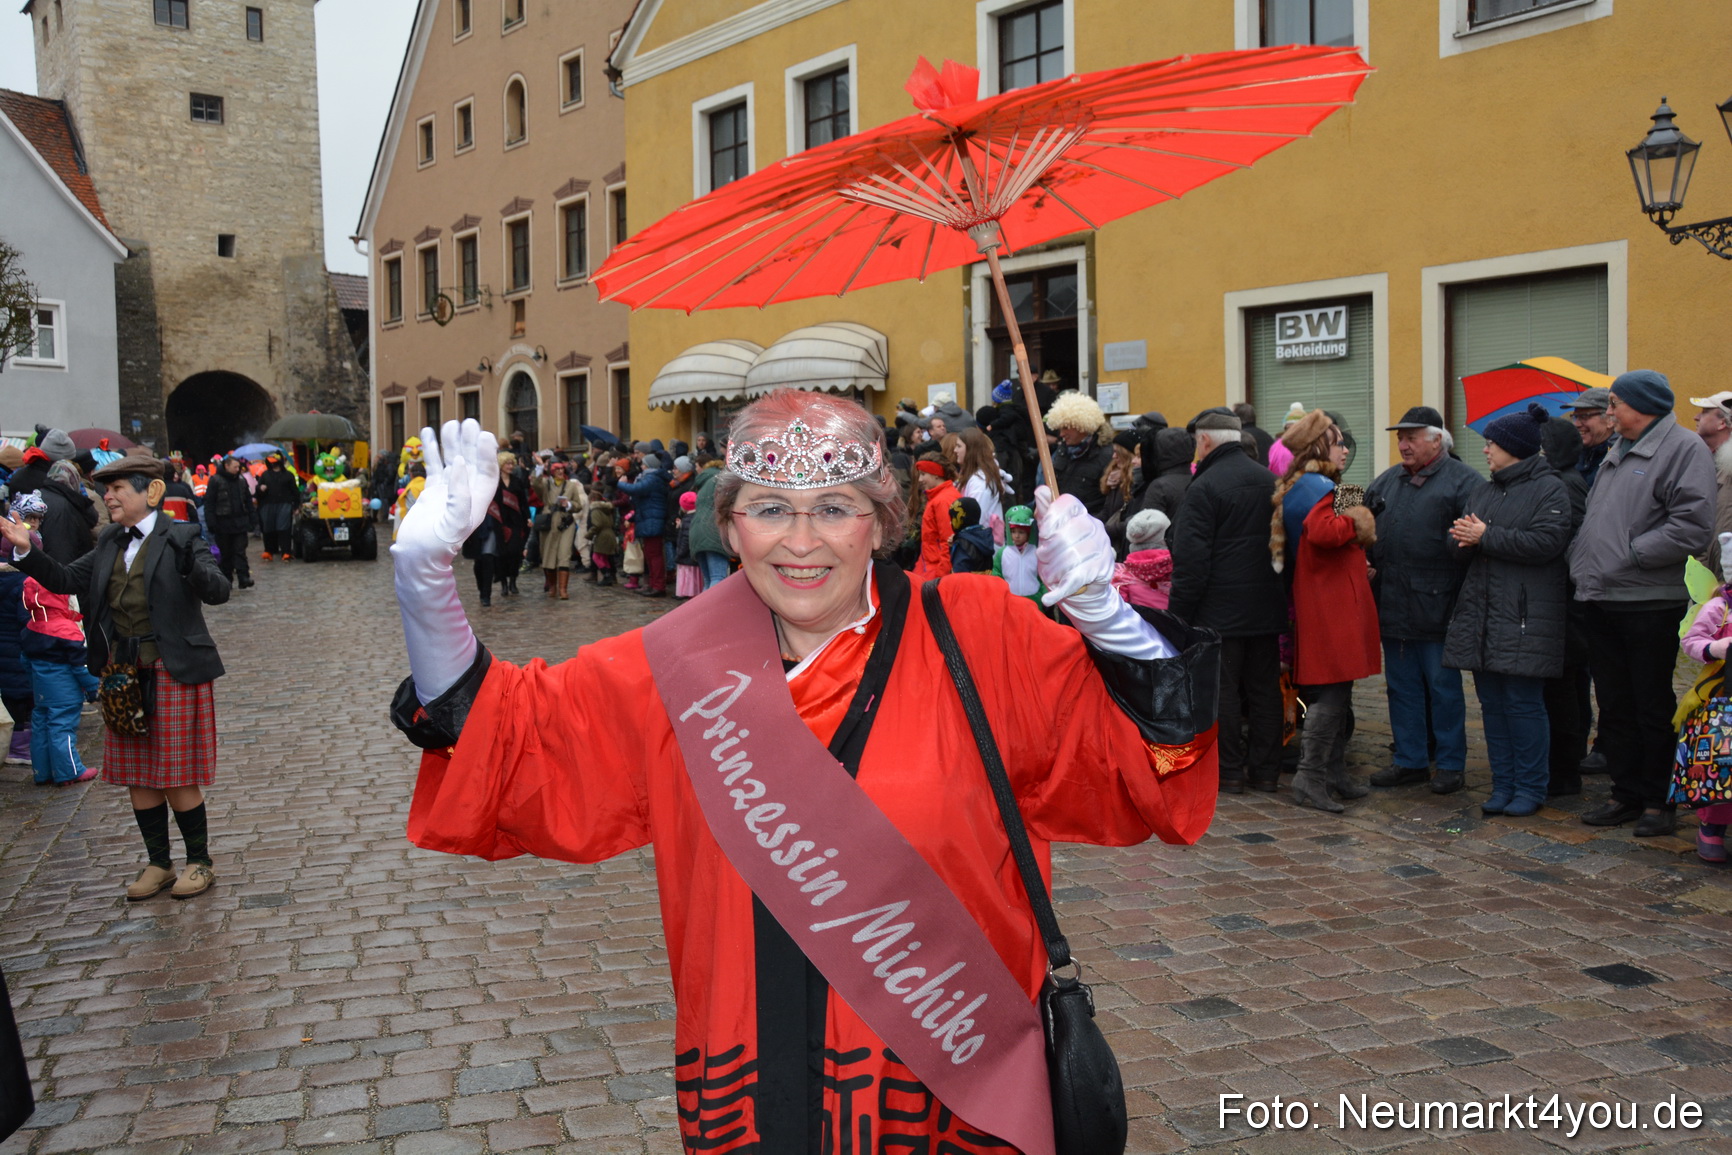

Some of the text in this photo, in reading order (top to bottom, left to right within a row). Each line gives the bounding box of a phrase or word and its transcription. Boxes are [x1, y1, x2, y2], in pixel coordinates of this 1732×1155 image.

[1279, 310, 1343, 341] BW
[1276, 342, 1346, 359] Bekleidung
[679, 669, 848, 907] Prinzessin
[809, 899, 989, 1065] Michiko
